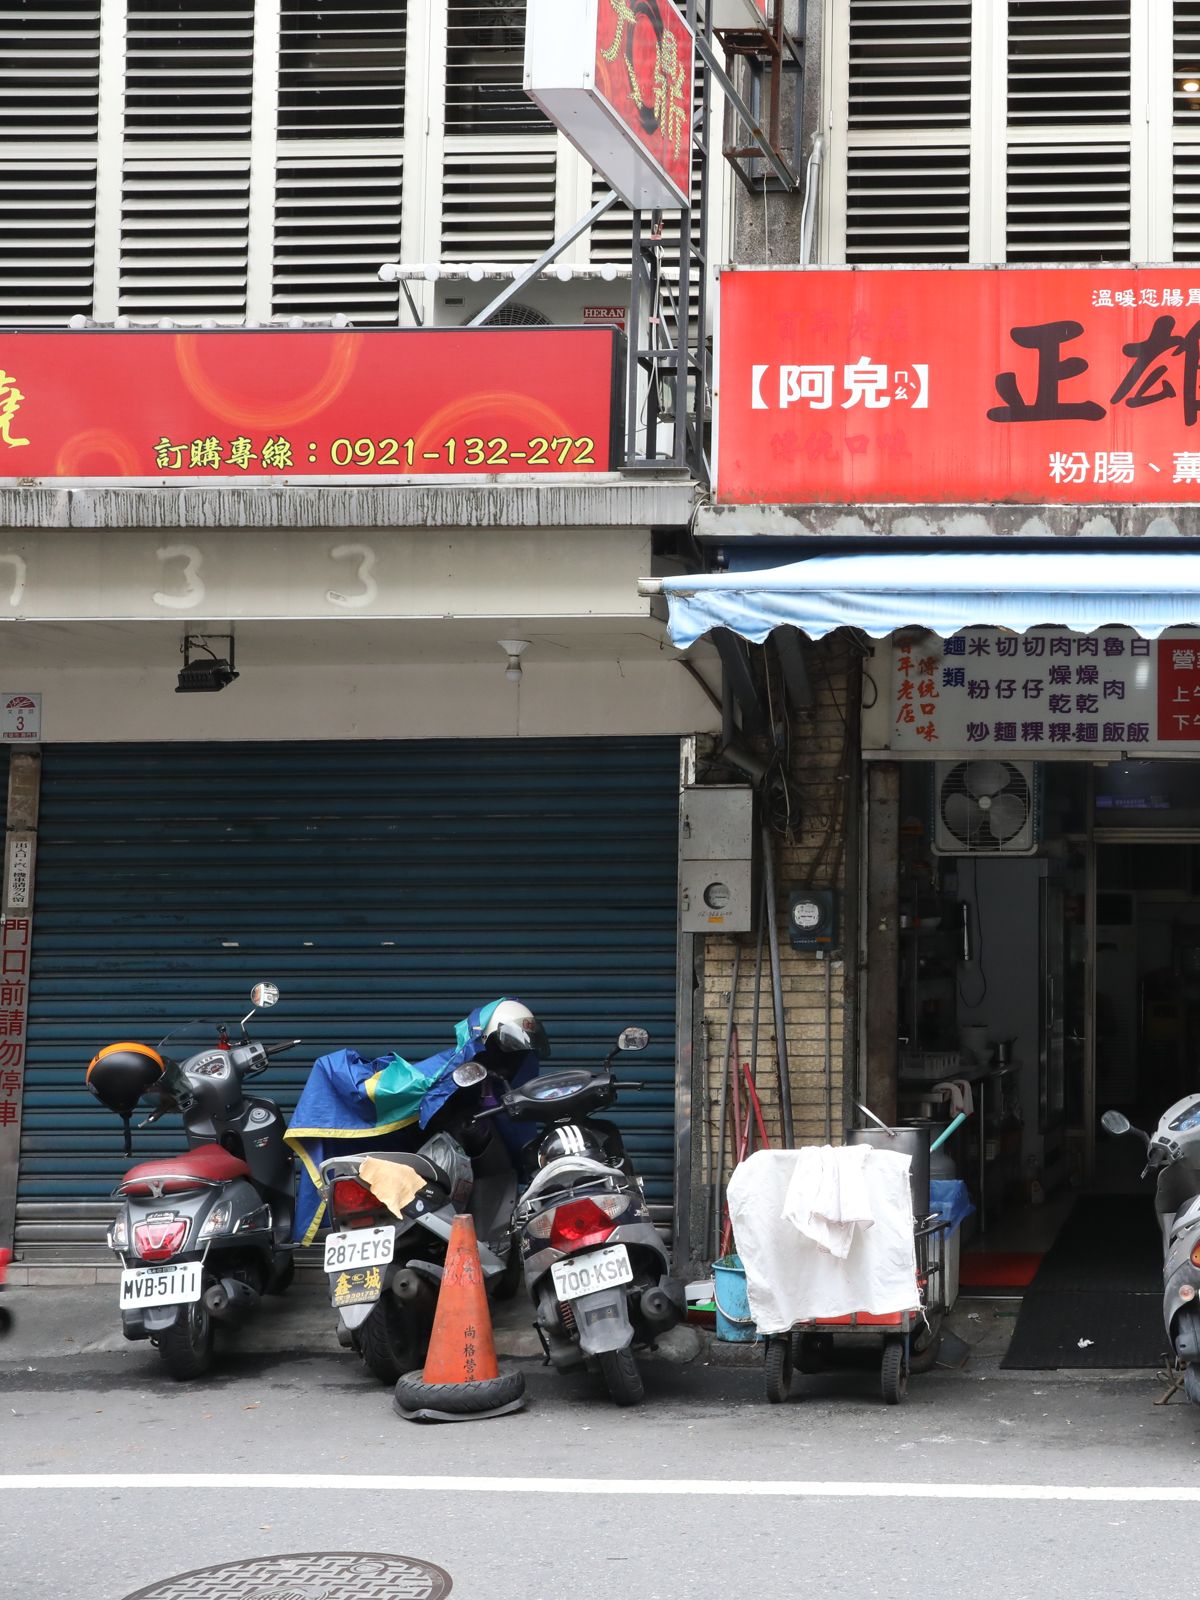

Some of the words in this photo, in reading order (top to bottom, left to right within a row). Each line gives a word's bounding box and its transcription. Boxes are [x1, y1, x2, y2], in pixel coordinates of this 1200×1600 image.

[584, 308, 625, 319] HERAN
[942, 636, 966, 688] 麵類
[966, 637, 991, 742] 米粉炒
[994, 637, 1018, 742] 切仔麵
[1021, 637, 1046, 742] 切仔粿
[1048, 637, 1072, 743] 肉燥乾粿
[1075, 637, 1100, 743] 肉燥乾麵
[1102, 637, 1126, 743] 魯肉飯
[16, 716, 25, 731] 3
